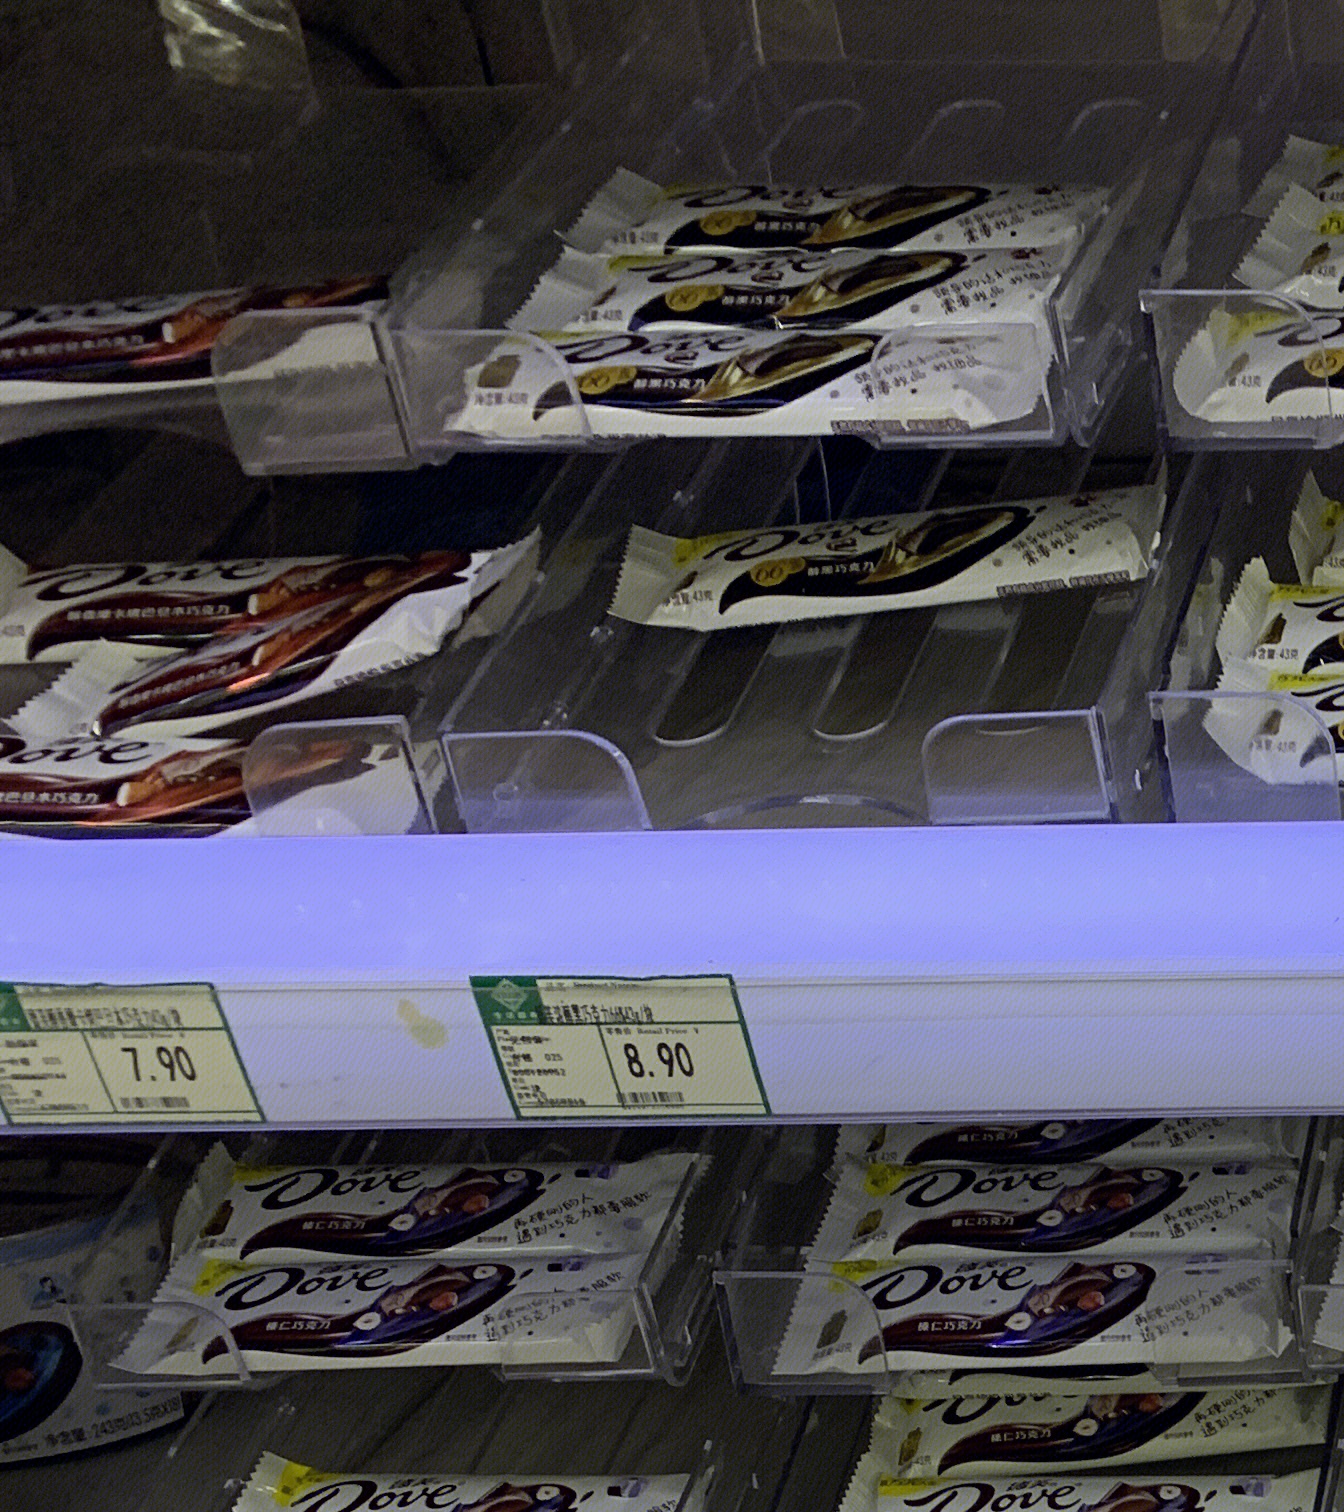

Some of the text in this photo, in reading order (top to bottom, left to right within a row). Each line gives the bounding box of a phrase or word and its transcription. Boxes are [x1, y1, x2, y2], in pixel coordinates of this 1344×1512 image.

[121, 1046, 196, 1081] 7.90
[623, 1042, 694, 1078] 8.90
[244, 1168, 426, 1211] Dove
[889, 1167, 1065, 1208] Dove
[215, 1266, 393, 1311] Dove
